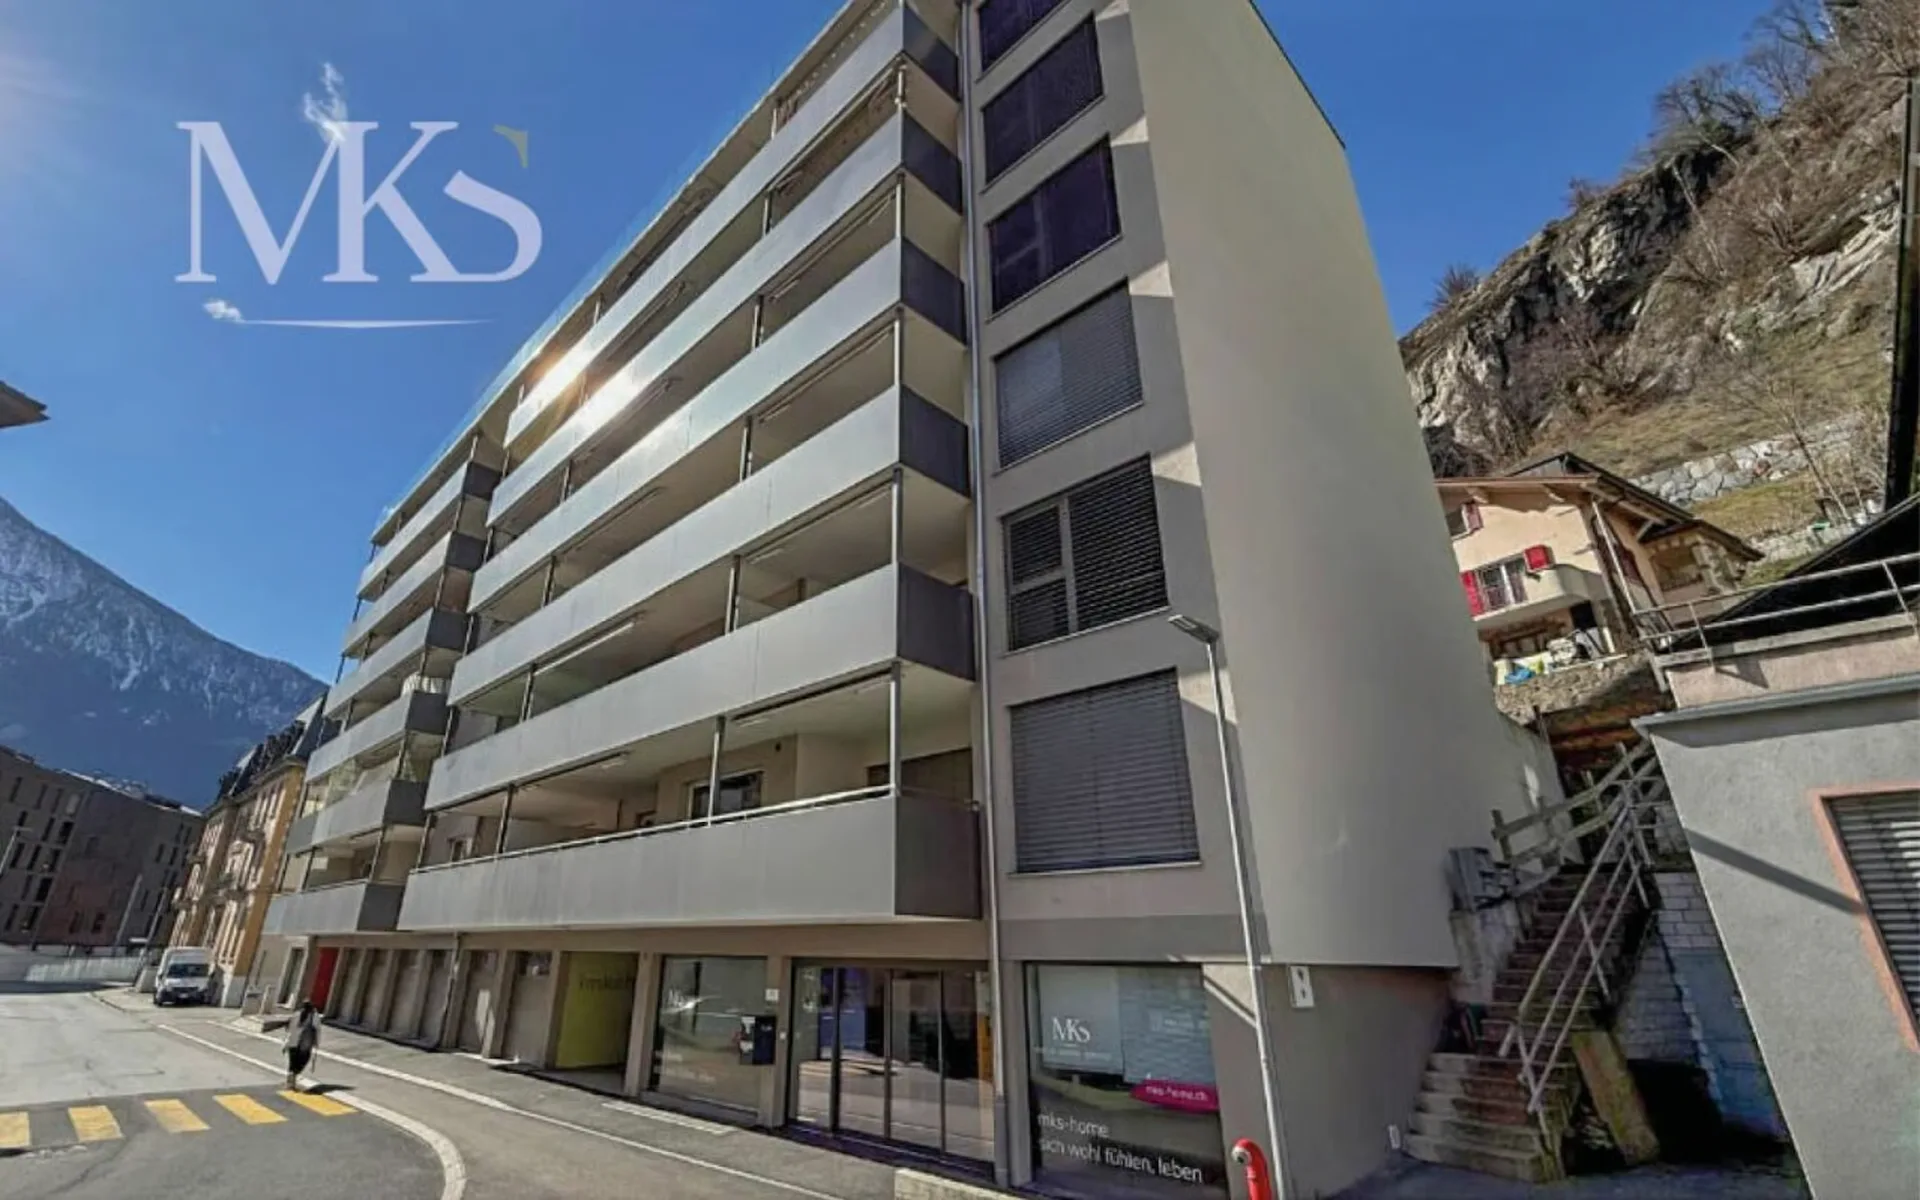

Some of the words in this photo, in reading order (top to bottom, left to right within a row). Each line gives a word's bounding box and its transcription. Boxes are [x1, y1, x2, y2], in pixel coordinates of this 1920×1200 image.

[1038, 1112, 1109, 1138] mks-home
[1067, 1143, 1101, 1164] wohl
[1158, 1156, 1203, 1184] leben
